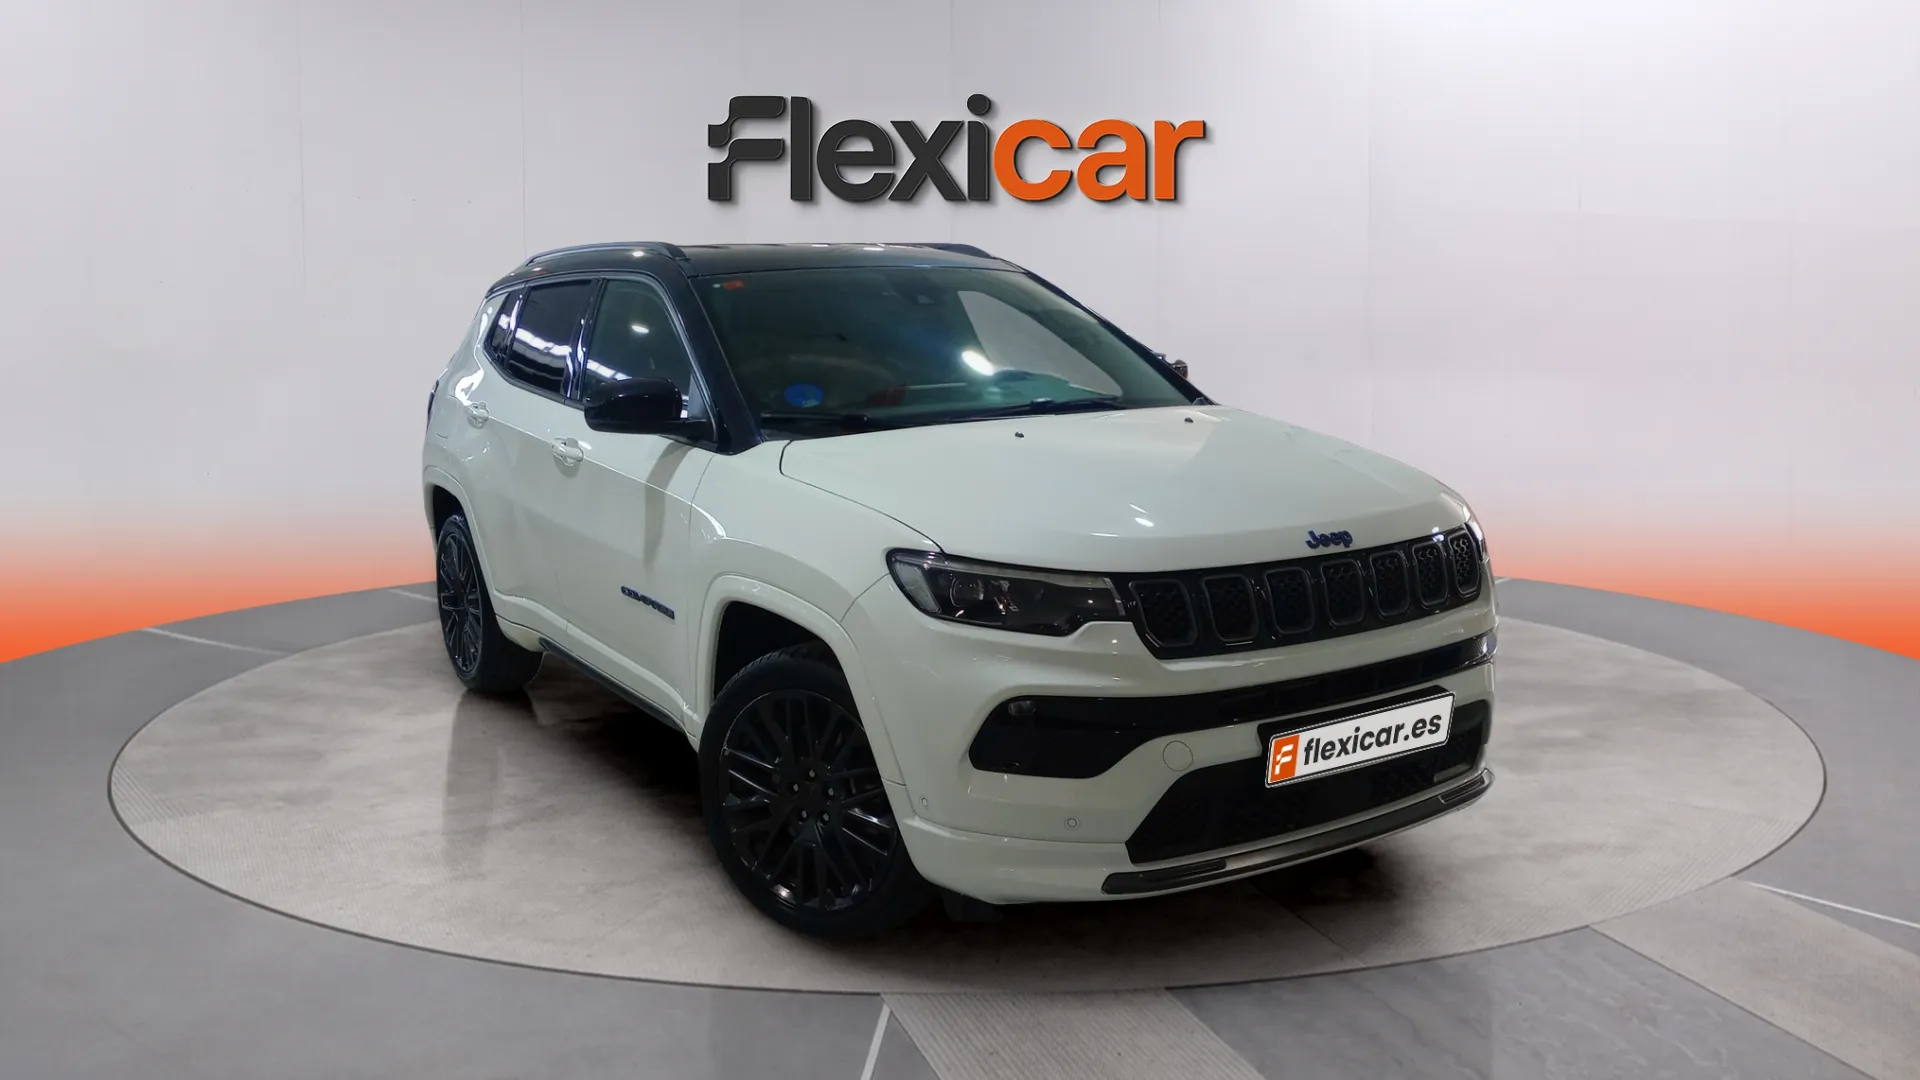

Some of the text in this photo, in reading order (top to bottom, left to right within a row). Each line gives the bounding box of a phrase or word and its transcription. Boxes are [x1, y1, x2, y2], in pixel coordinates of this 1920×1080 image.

[707, 93, 1205, 202] Flexicar
[1305, 530, 1353, 549] Jeep
[1303, 714, 1442, 766] flexicar.es
